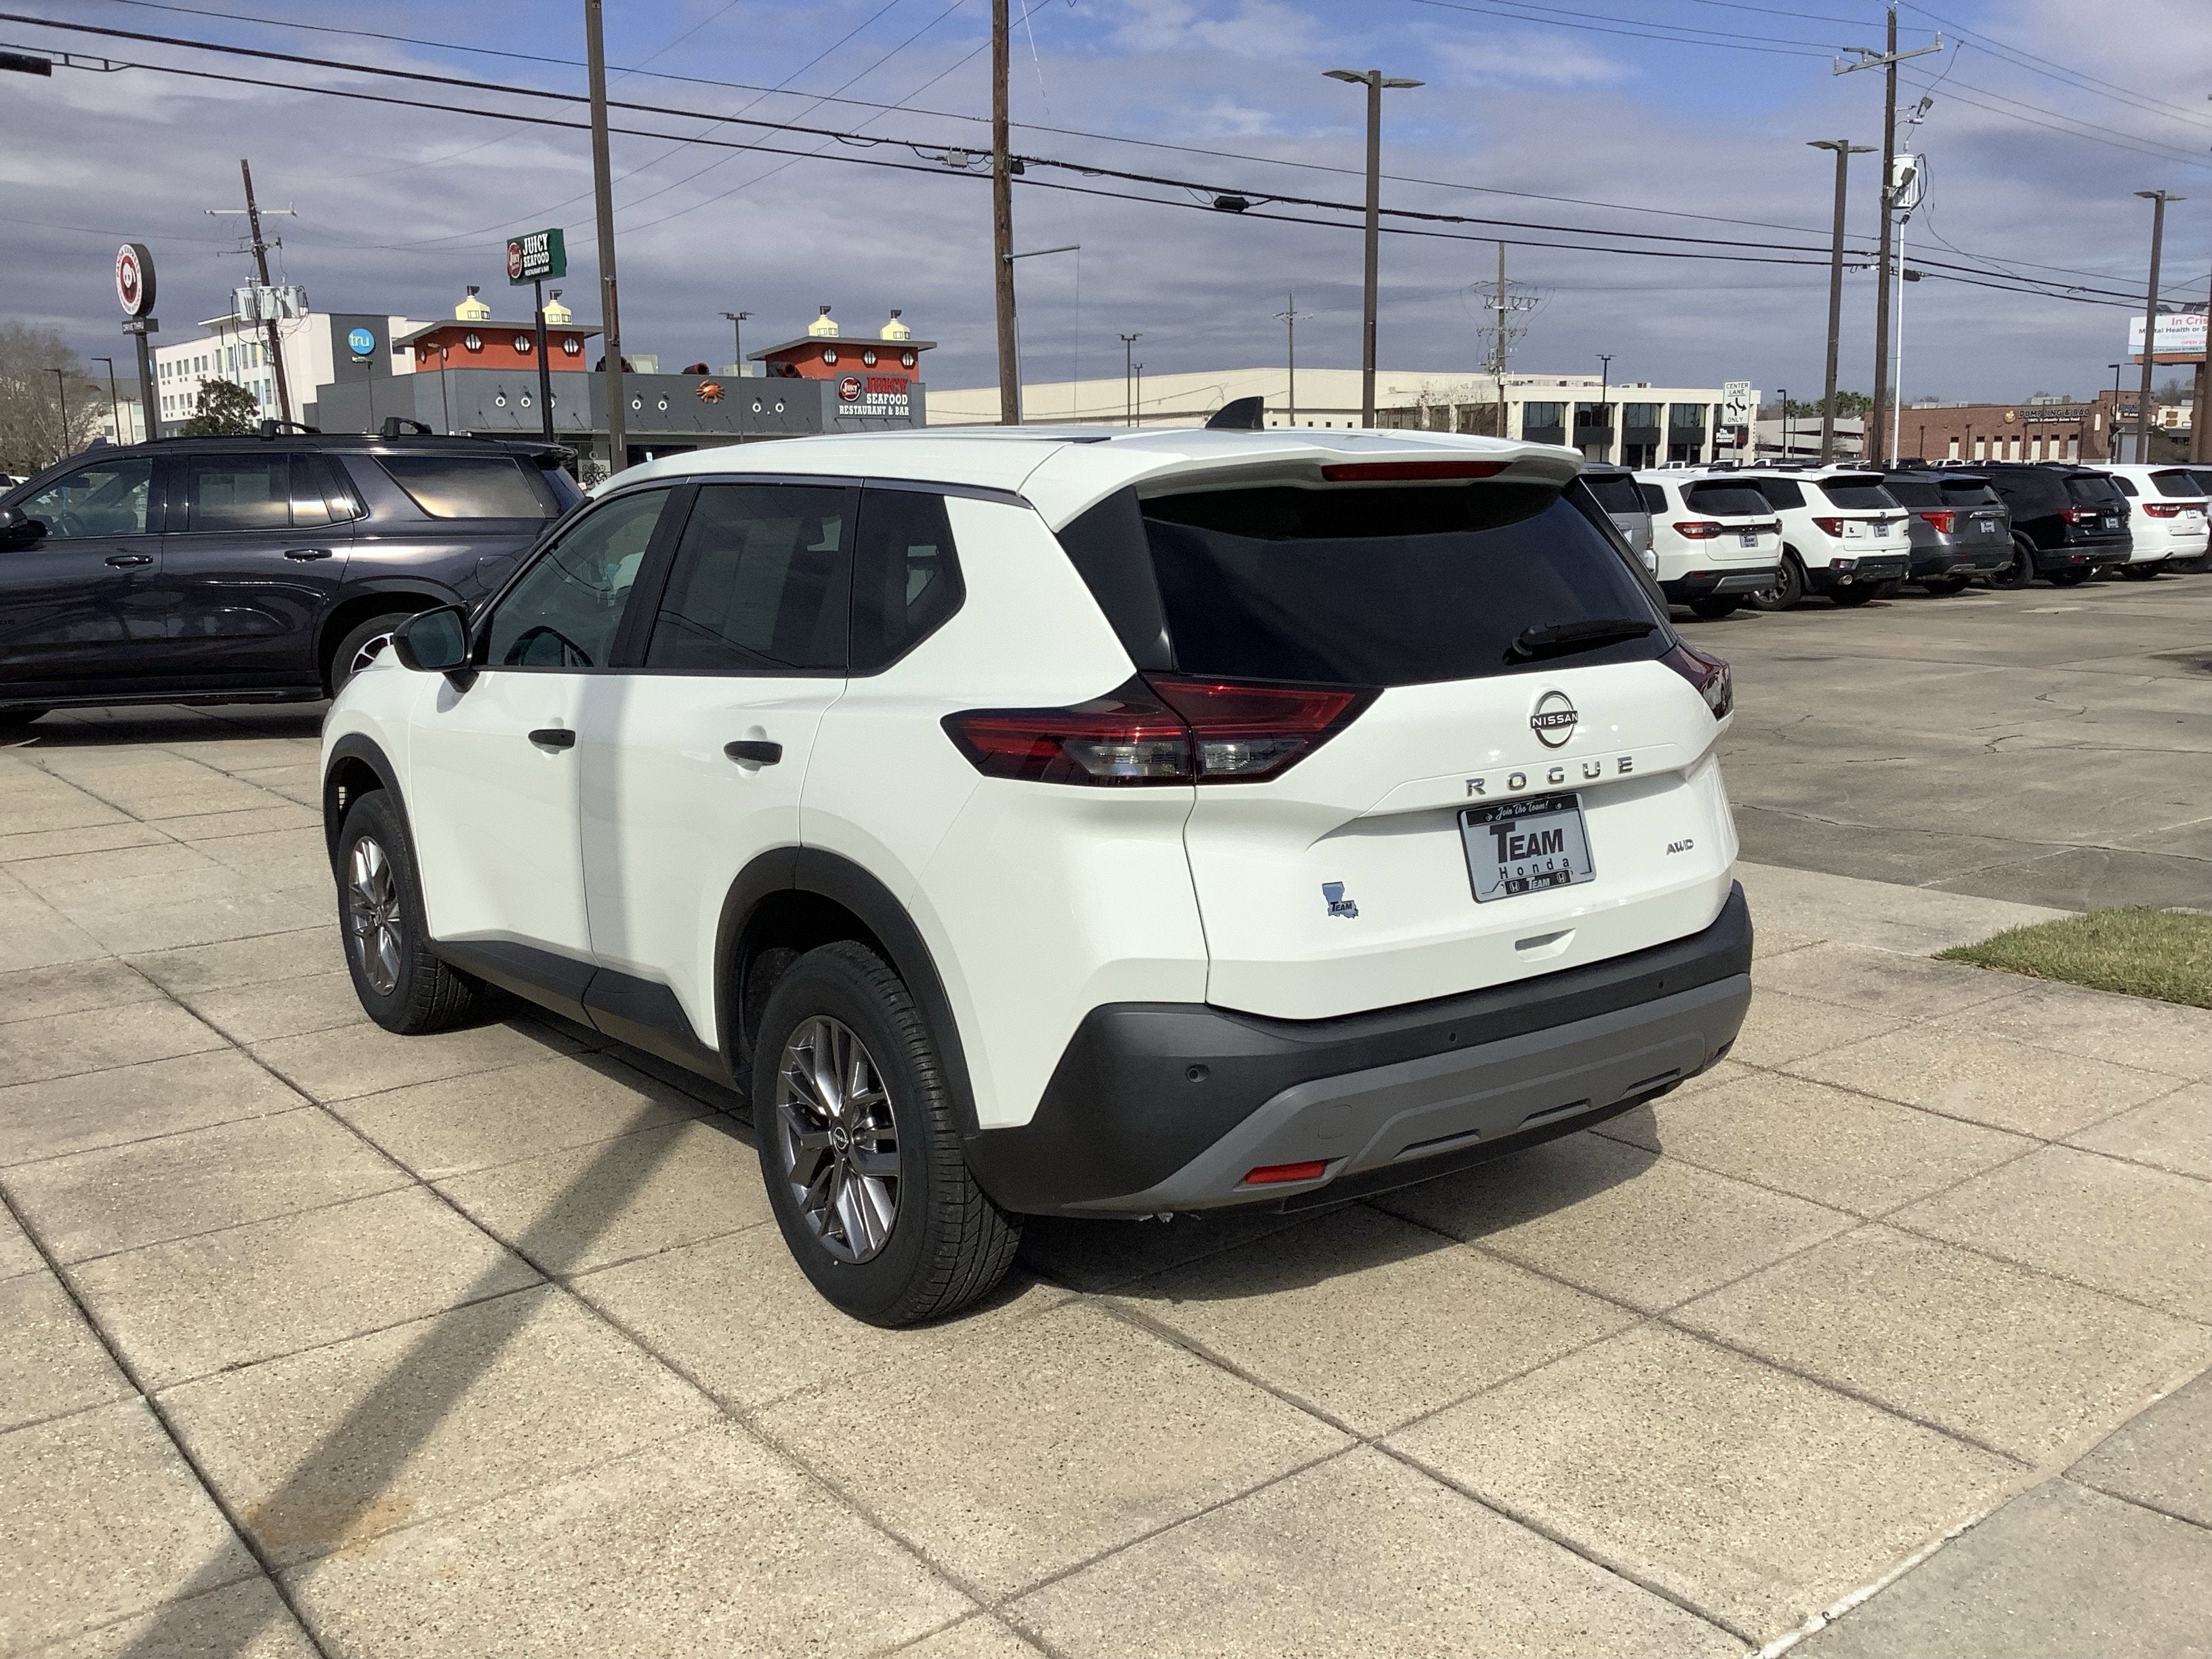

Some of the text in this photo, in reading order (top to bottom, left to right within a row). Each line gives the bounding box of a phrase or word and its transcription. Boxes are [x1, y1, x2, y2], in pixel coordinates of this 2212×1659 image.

[523, 233, 548, 255] JUICY
[523, 251, 549, 268] SEAFOOD
[2172, 317, 2182, 325] In
[348, 333, 369, 347] tru
[864, 376, 908, 394] JUICY
[866, 393, 908, 405] SEAFOOD
[839, 405, 909, 415] RESTAURANT & BAR
[2019, 409, 2062, 417] DUMPLING
[1532, 712, 1578, 728] NISSAN
[1466, 756, 1633, 797] ROGUE
[1495, 806, 1513, 821] Join
[1513, 804, 1526, 815] The
[1490, 821, 1563, 863] TEAM
[1666, 839, 1694, 855] AWD
[1499, 857, 1570, 879] Honda
[1526, 877, 1550, 890] TEAM
[1330, 901, 1353, 912] TEAM
